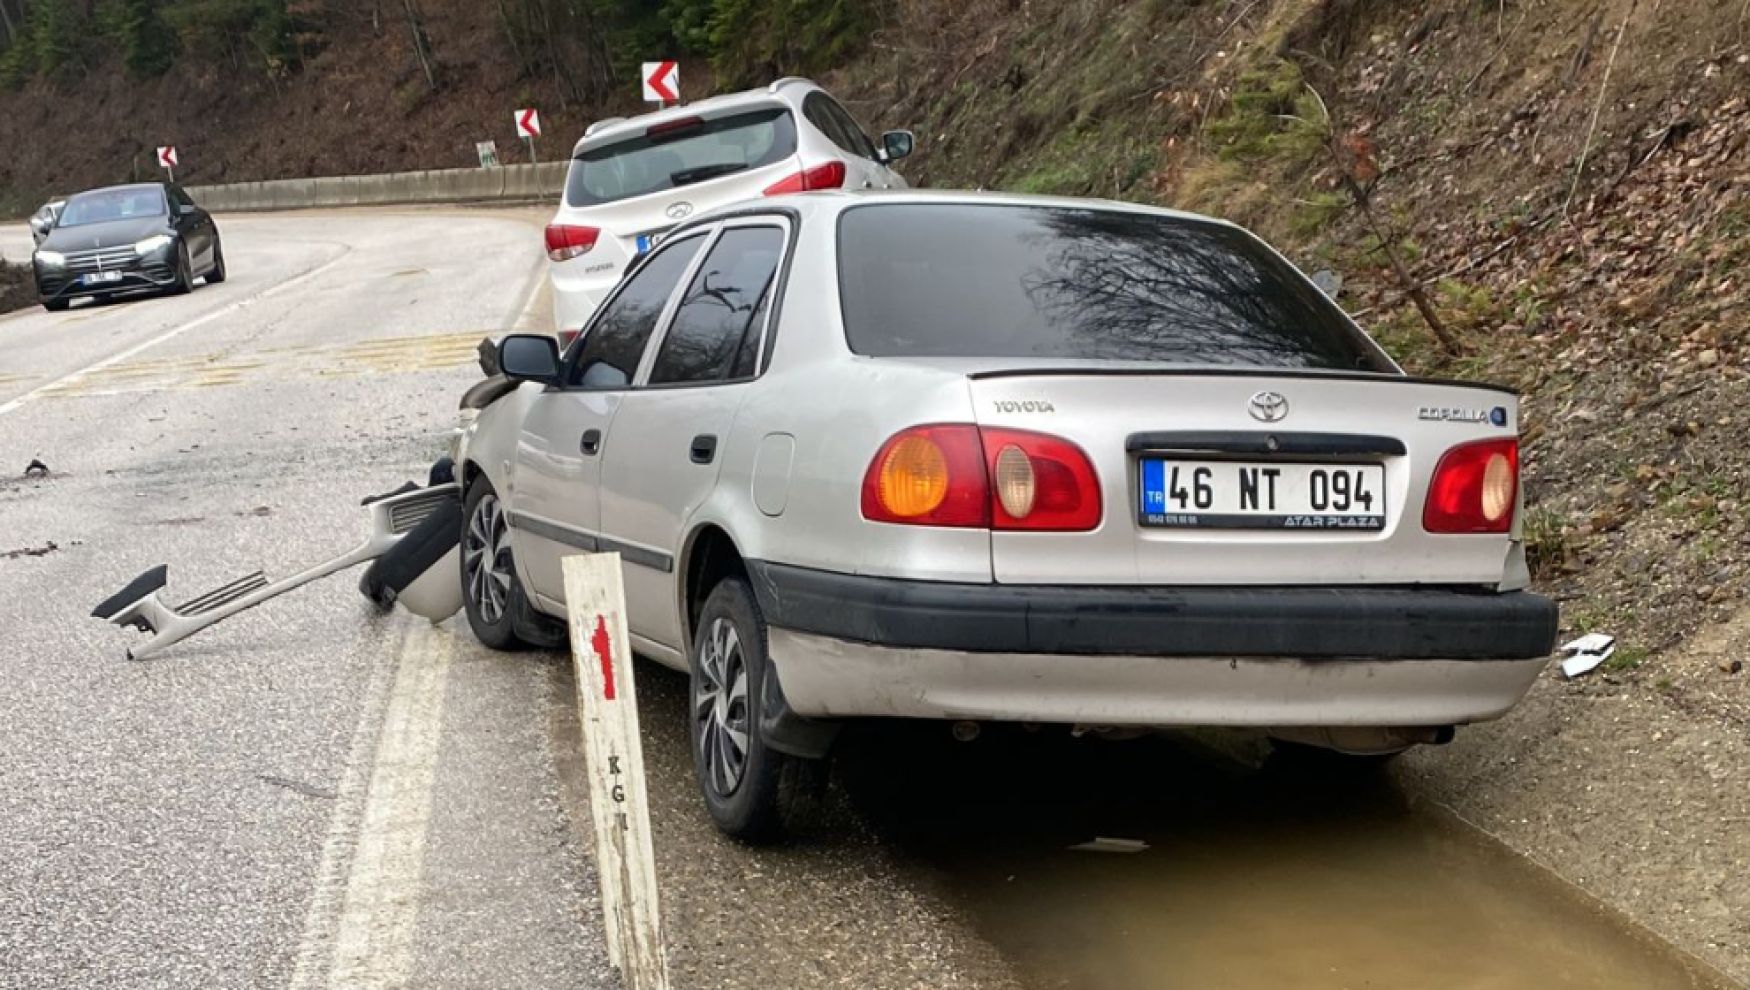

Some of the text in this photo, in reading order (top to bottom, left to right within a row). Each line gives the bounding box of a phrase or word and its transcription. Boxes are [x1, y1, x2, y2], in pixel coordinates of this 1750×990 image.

[992, 400, 1056, 413] TOYOTA
[1169, 465, 1373, 512] 46 NT 094
[1147, 490, 1164, 504] TR
[1284, 515, 1380, 527] ATAR PLAZA
